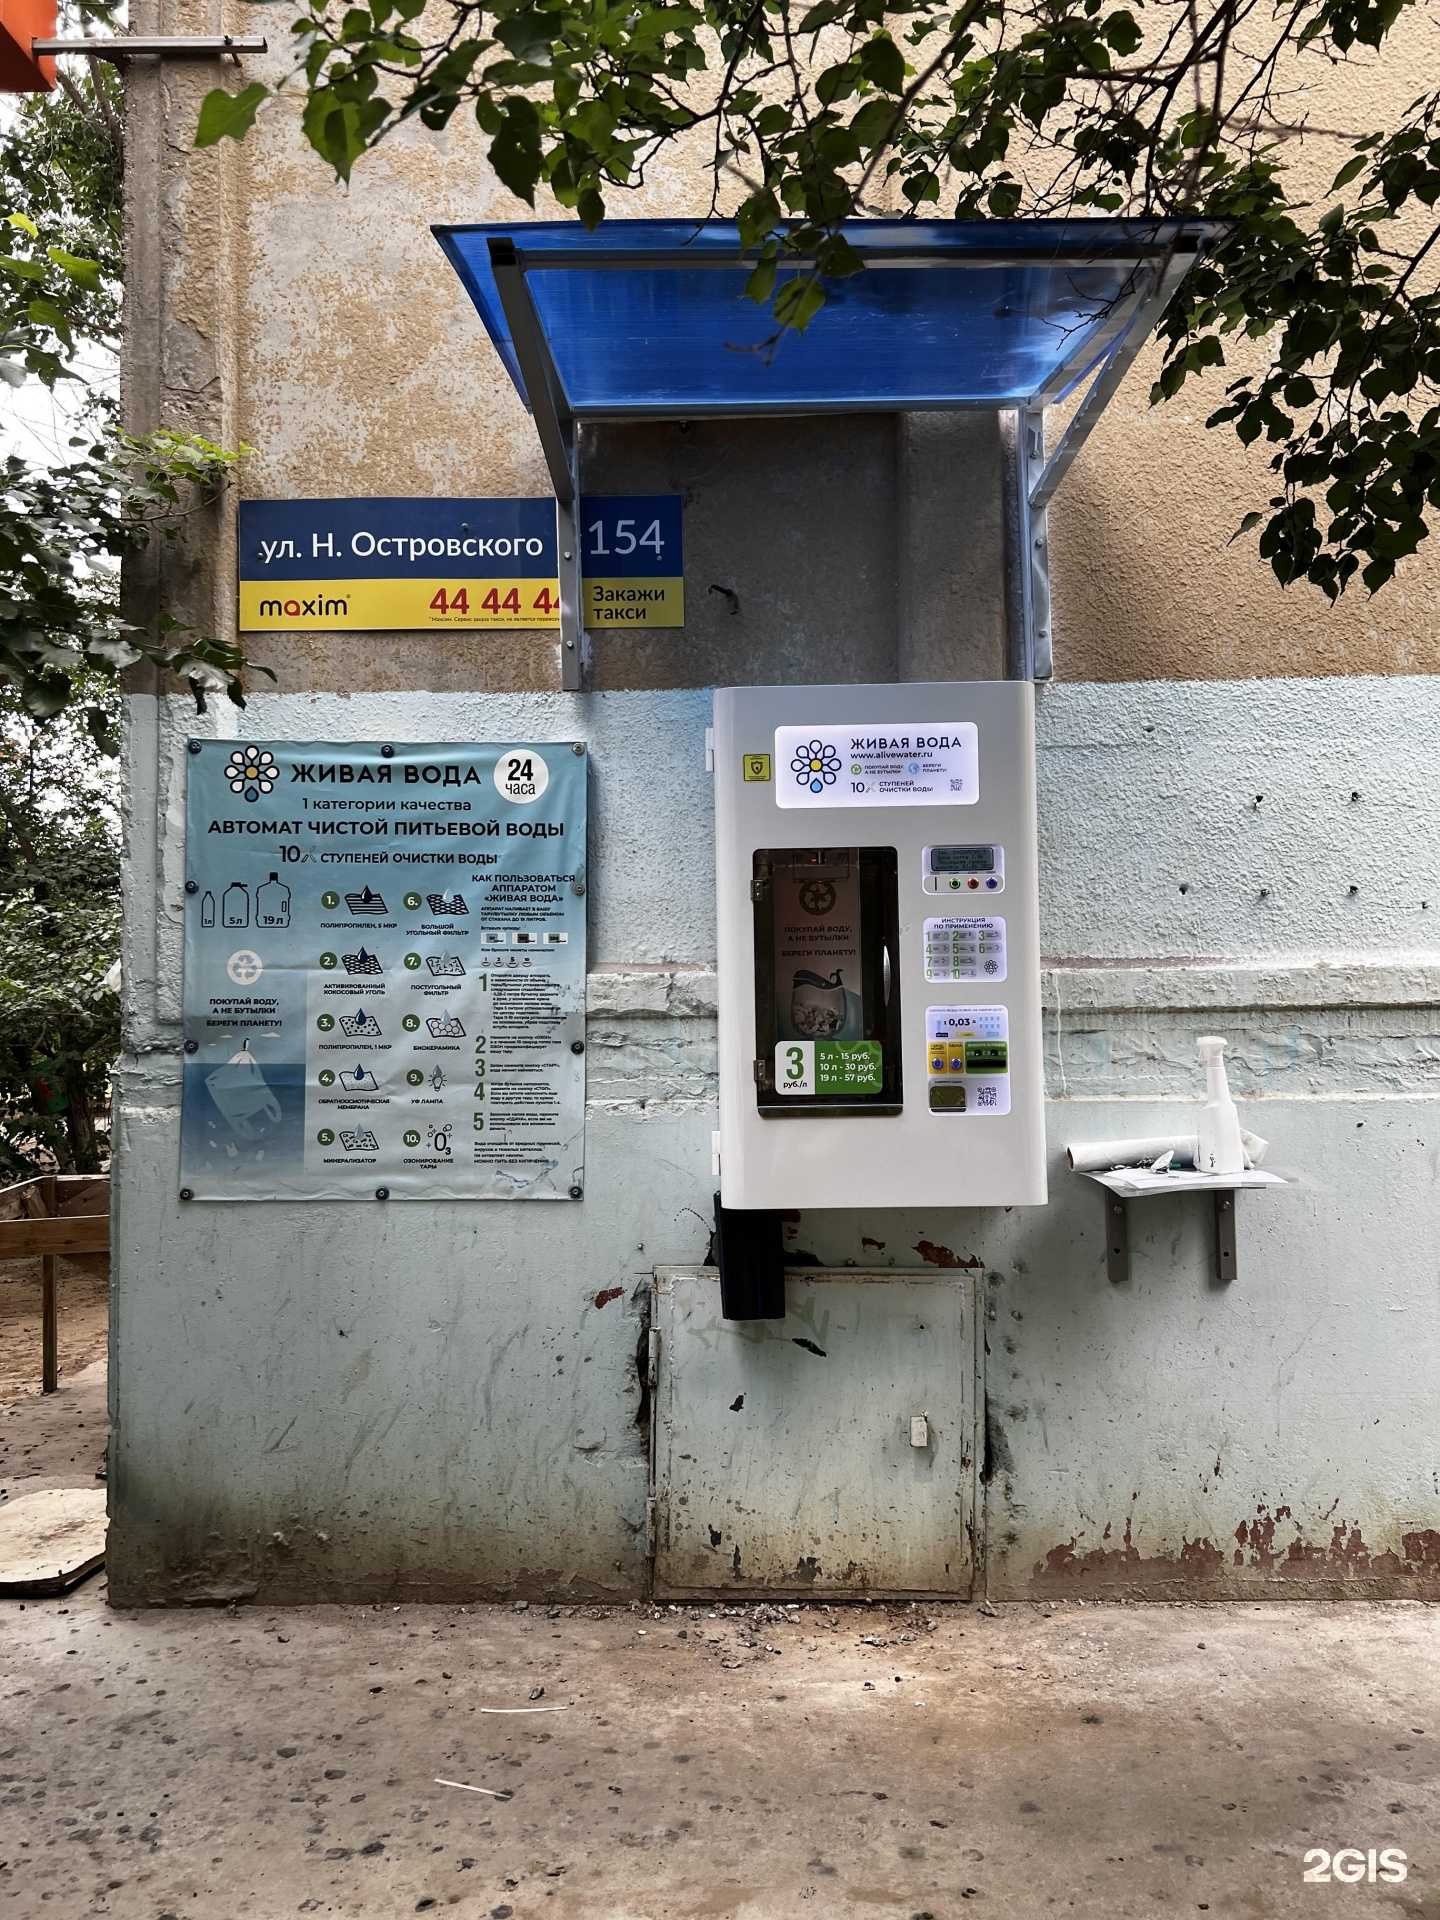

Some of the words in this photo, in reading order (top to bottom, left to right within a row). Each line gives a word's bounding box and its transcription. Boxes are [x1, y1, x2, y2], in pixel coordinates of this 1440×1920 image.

[260, 539, 301, 564] ул.
[312, 532, 342, 558] Н.
[351, 531, 543, 562] Островского
[588, 519, 665, 555] 154
[593, 585, 665, 602] Закажи
[259, 593, 347, 616] maxim
[429, 587, 469, 615] 44
[481, 587, 522, 615] 44
[593, 606, 646, 620] такси
[850, 737, 909, 750] ЖИВАЯ
[916, 736, 962, 750] ВОДА
[850, 751, 933, 760] www.alivewater.ru
[507, 758, 534, 782] 24
[290, 764, 392, 784] ЖИВАЯ
[404, 765, 482, 788] ВОДА
[505, 783, 536, 795] часа
[850, 782, 865, 793] 10
[302, 798, 308, 810] 1
[313, 799, 396, 812] категории
[401, 800, 472, 811] качества
[207, 820, 303, 835] АВТОМАТ
[308, 818, 388, 835] ЧИСТОЙ
[394, 820, 500, 836] ПИТЬЕВОЙ
[506, 822, 564, 839] ВОДЫ
[279, 845, 301, 863] 10
[320, 851, 389, 863] СТУПЕНЕЙ
[392, 853, 454, 864] ОЧИСТКИ
[458, 854, 497, 865] ВОДЫ
[471, 874, 492, 882] КАК
[494, 874, 576, 883] ПОЛЬЗОВАТЬСЯ
[491, 884, 556, 892] АППАРАТОМ
[326, 896, 335, 905] 1.
[407, 896, 418, 906] 6.
[484, 894, 527, 902] «ЖИВАЯ
[529, 895, 563, 903] ВОДА»
[323, 957, 334, 965] 2.
[407, 957, 418, 966] 7.
[478, 973, 487, 991] 1
[209, 997, 253, 1005] ПОКУПАЙ
[253, 998, 279, 1006] ВОДУ,
[321, 1019, 331, 1027] 3.
[406, 1019, 417, 1027] 8.
[948, 1018, 971, 1027] 0,03
[475, 1036, 486, 1054] 2
[851, 1052, 870, 1061] руб.
[474, 1058, 485, 1077] 3
[786, 1046, 804, 1080] 3
[819, 1063, 829, 1071] 10
[845, 1063, 856, 1071] 30
[857, 1063, 877, 1072] руб.
[321, 1074, 332, 1082] 4.
[410, 1073, 421, 1082] 9.
[820, 1074, 829, 1082] 19
[856, 1073, 876, 1082] руб.
[783, 1081, 808, 1089] руб./л
[474, 1082, 485, 1101] 4
[473, 1112, 484, 1131] 5
[321, 1133, 331, 1141] 5.
[405, 1135, 419, 1143] 10.
